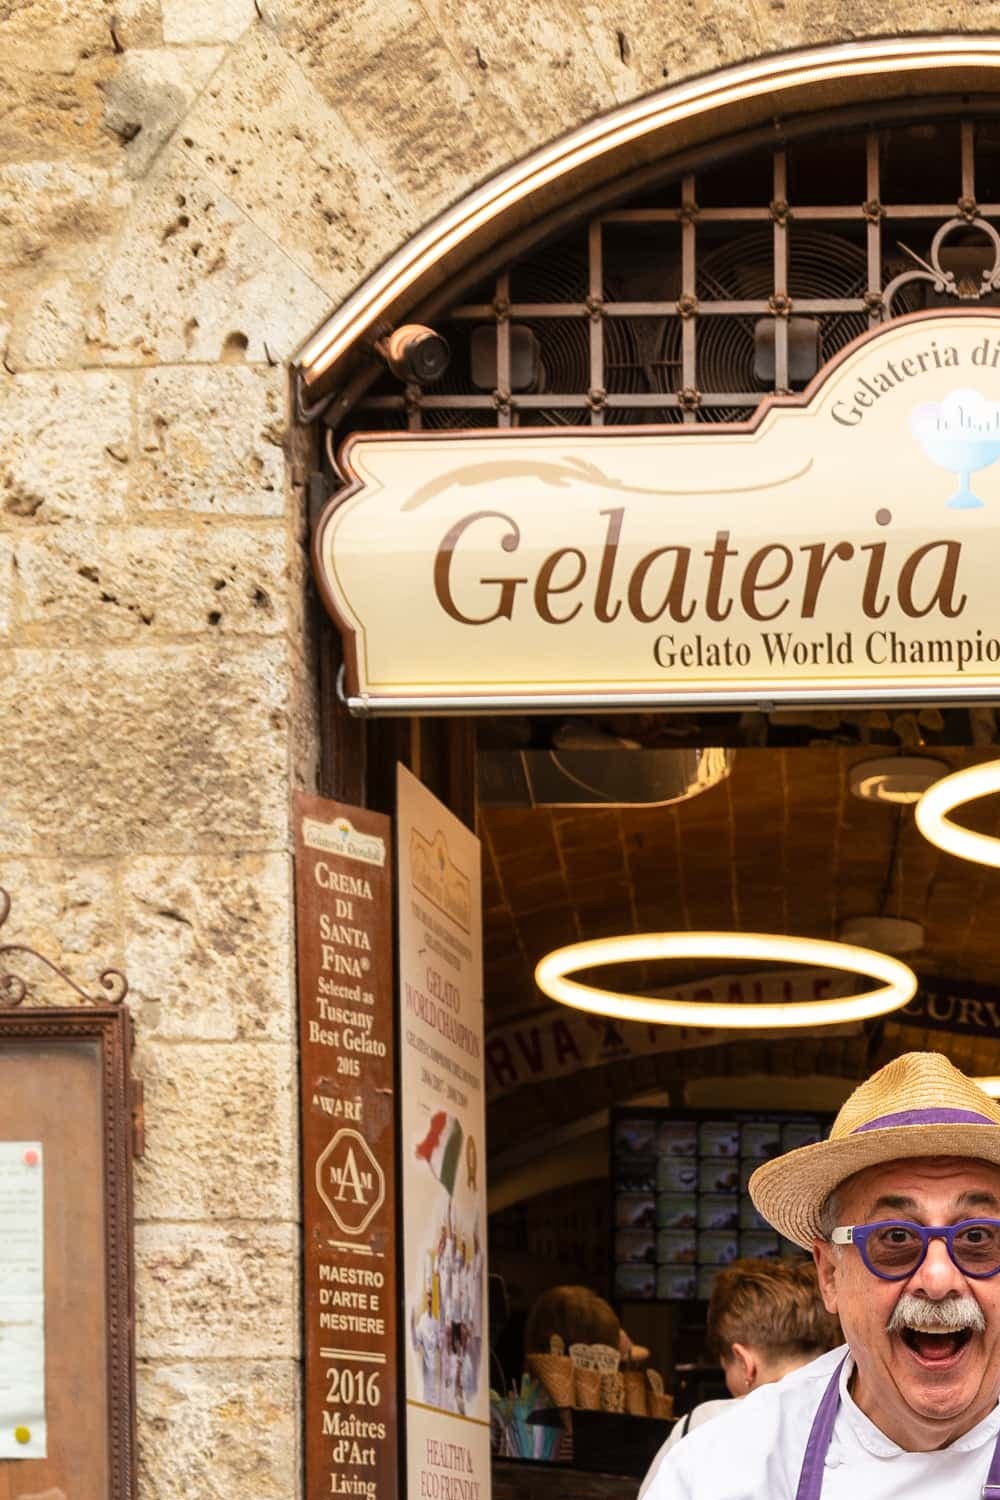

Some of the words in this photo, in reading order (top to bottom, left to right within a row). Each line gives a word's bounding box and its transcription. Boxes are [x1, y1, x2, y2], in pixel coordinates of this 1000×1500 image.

[829, 341, 960, 427] Gelateria
[433, 507, 968, 627] Gelateria
[653, 634, 752, 668] Gelato
[760, 632, 854, 665] World
[314, 861, 373, 900] CREMA
[336, 899, 353, 920] DI
[319, 914, 371, 951] SANTA
[318, 976, 361, 1001] Selected
[362, 992, 374, 1005] as
[316, 997, 374, 1035] Tuscany
[309, 1020, 339, 1047] Best
[343, 1027, 387, 1057] Gelato
[336, 1056, 360, 1078] 2015
[319, 1264, 384, 1288] MAESTRO
[319, 1288, 367, 1310] D'ARTE
[370, 1294, 379, 1311] E
[319, 1312, 385, 1336] MESTIERE
[325, 1367, 381, 1407] 2016
[322, 1410, 386, 1439] Maîtres
